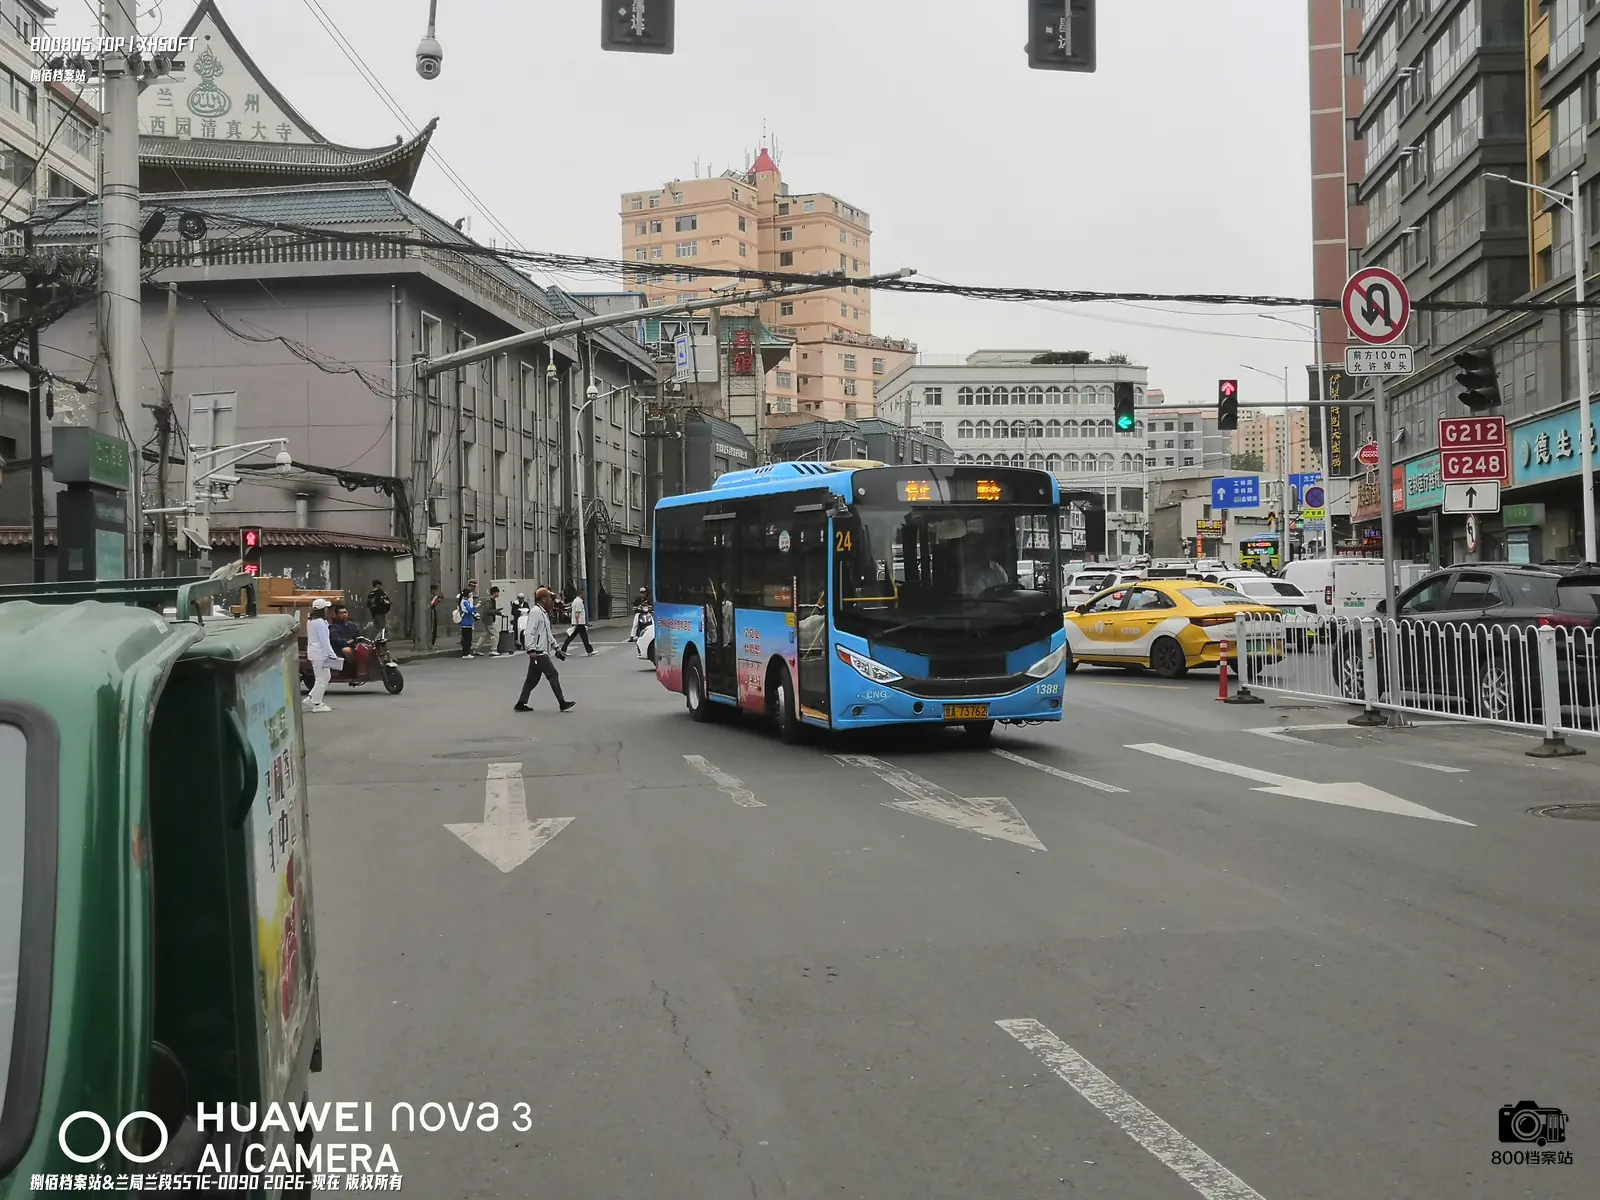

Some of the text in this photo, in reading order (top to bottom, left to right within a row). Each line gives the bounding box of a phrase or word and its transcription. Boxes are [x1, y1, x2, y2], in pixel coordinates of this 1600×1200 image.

[150, 115, 292, 142] 西园清真大寺
[1353, 350, 1407, 360] 前方100m
[1354, 362, 1407, 372] 允许掉头
[1445, 422, 1498, 442] G212
[1448, 455, 1500, 475] G248
[836, 531, 852, 551] 24
[866, 690, 887, 699] CNG
[1035, 684, 1059, 694] 1388
